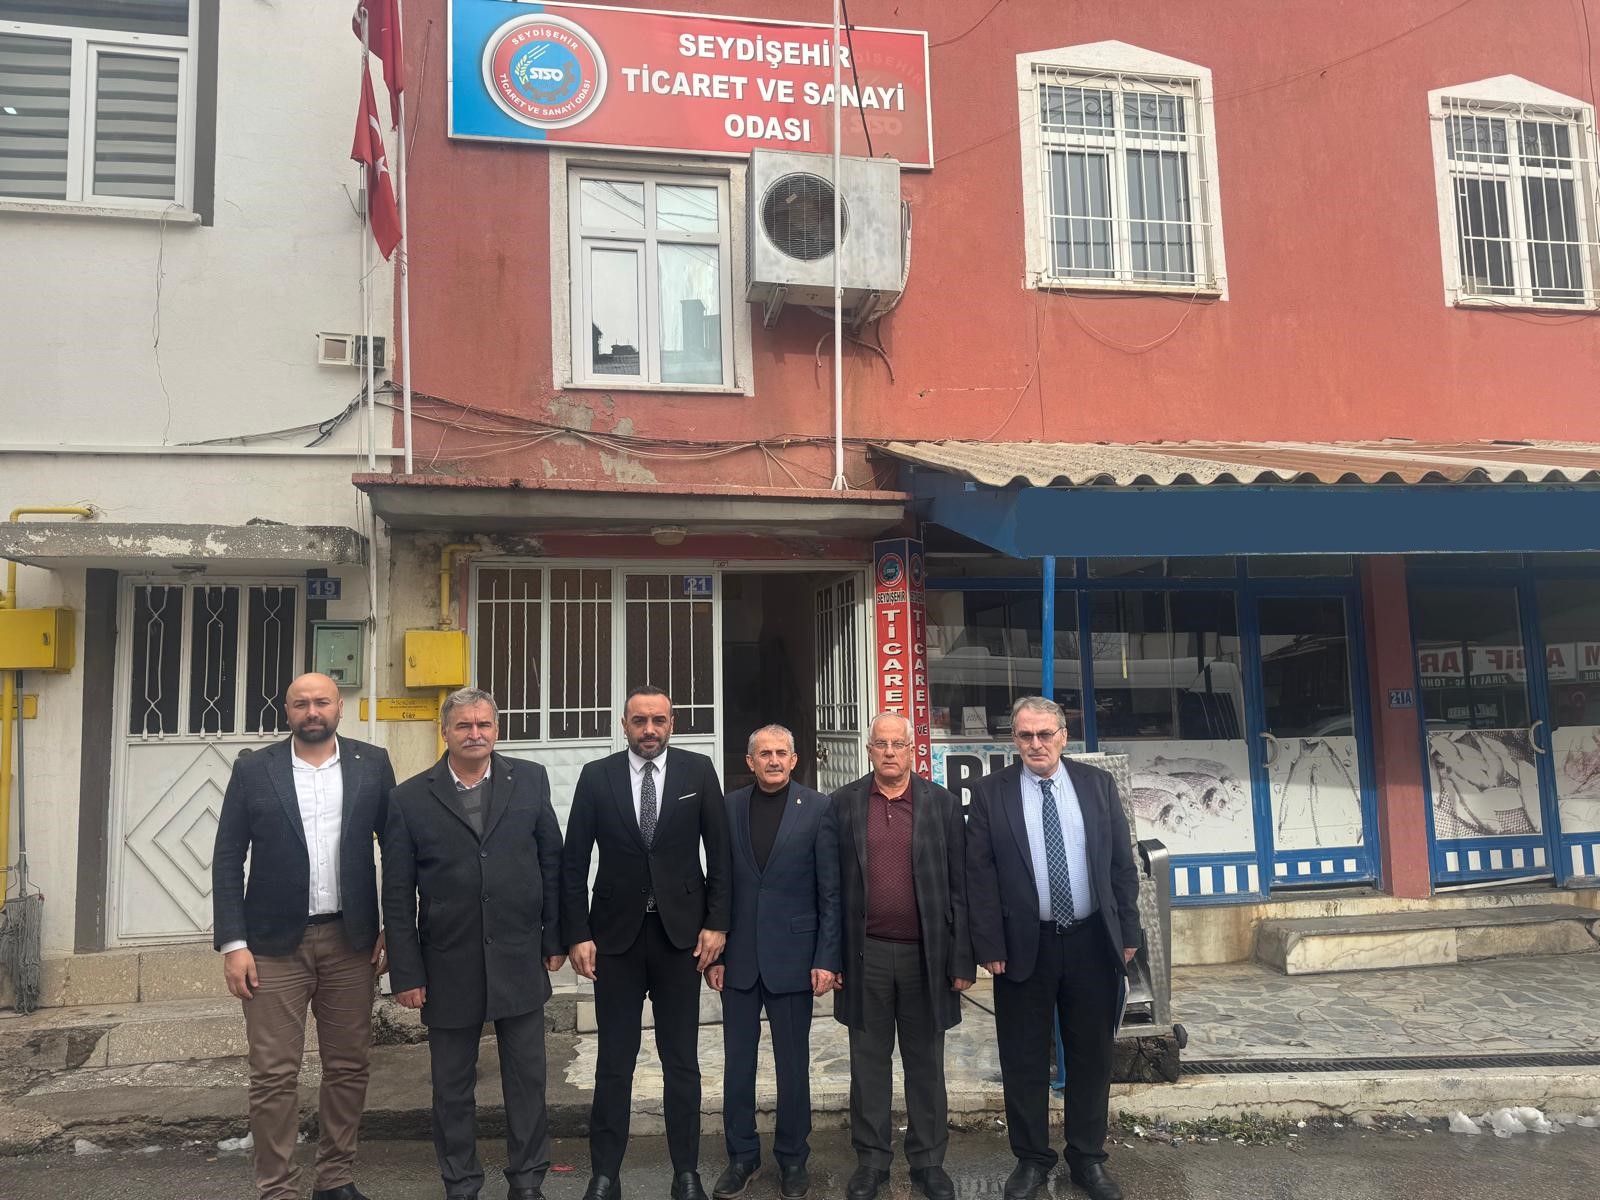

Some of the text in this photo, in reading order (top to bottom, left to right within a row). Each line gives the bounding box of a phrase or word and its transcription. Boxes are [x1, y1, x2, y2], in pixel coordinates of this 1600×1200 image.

[511, 28, 578, 50] SEYDİŞEHİR
[678, 33, 851, 68] SEYDİŞEHİR
[530, 67, 564, 82] STSO
[621, 63, 905, 111] TİCARET VE SANAYİ
[500, 73, 591, 116] TİCARET VE SANAYİ ODASI
[724, 113, 811, 142] ODASI
[311, 581, 336, 595] 19
[687, 578, 706, 591] 21
[913, 610, 927, 717] TİCARET
[917, 722, 928, 735] VE
